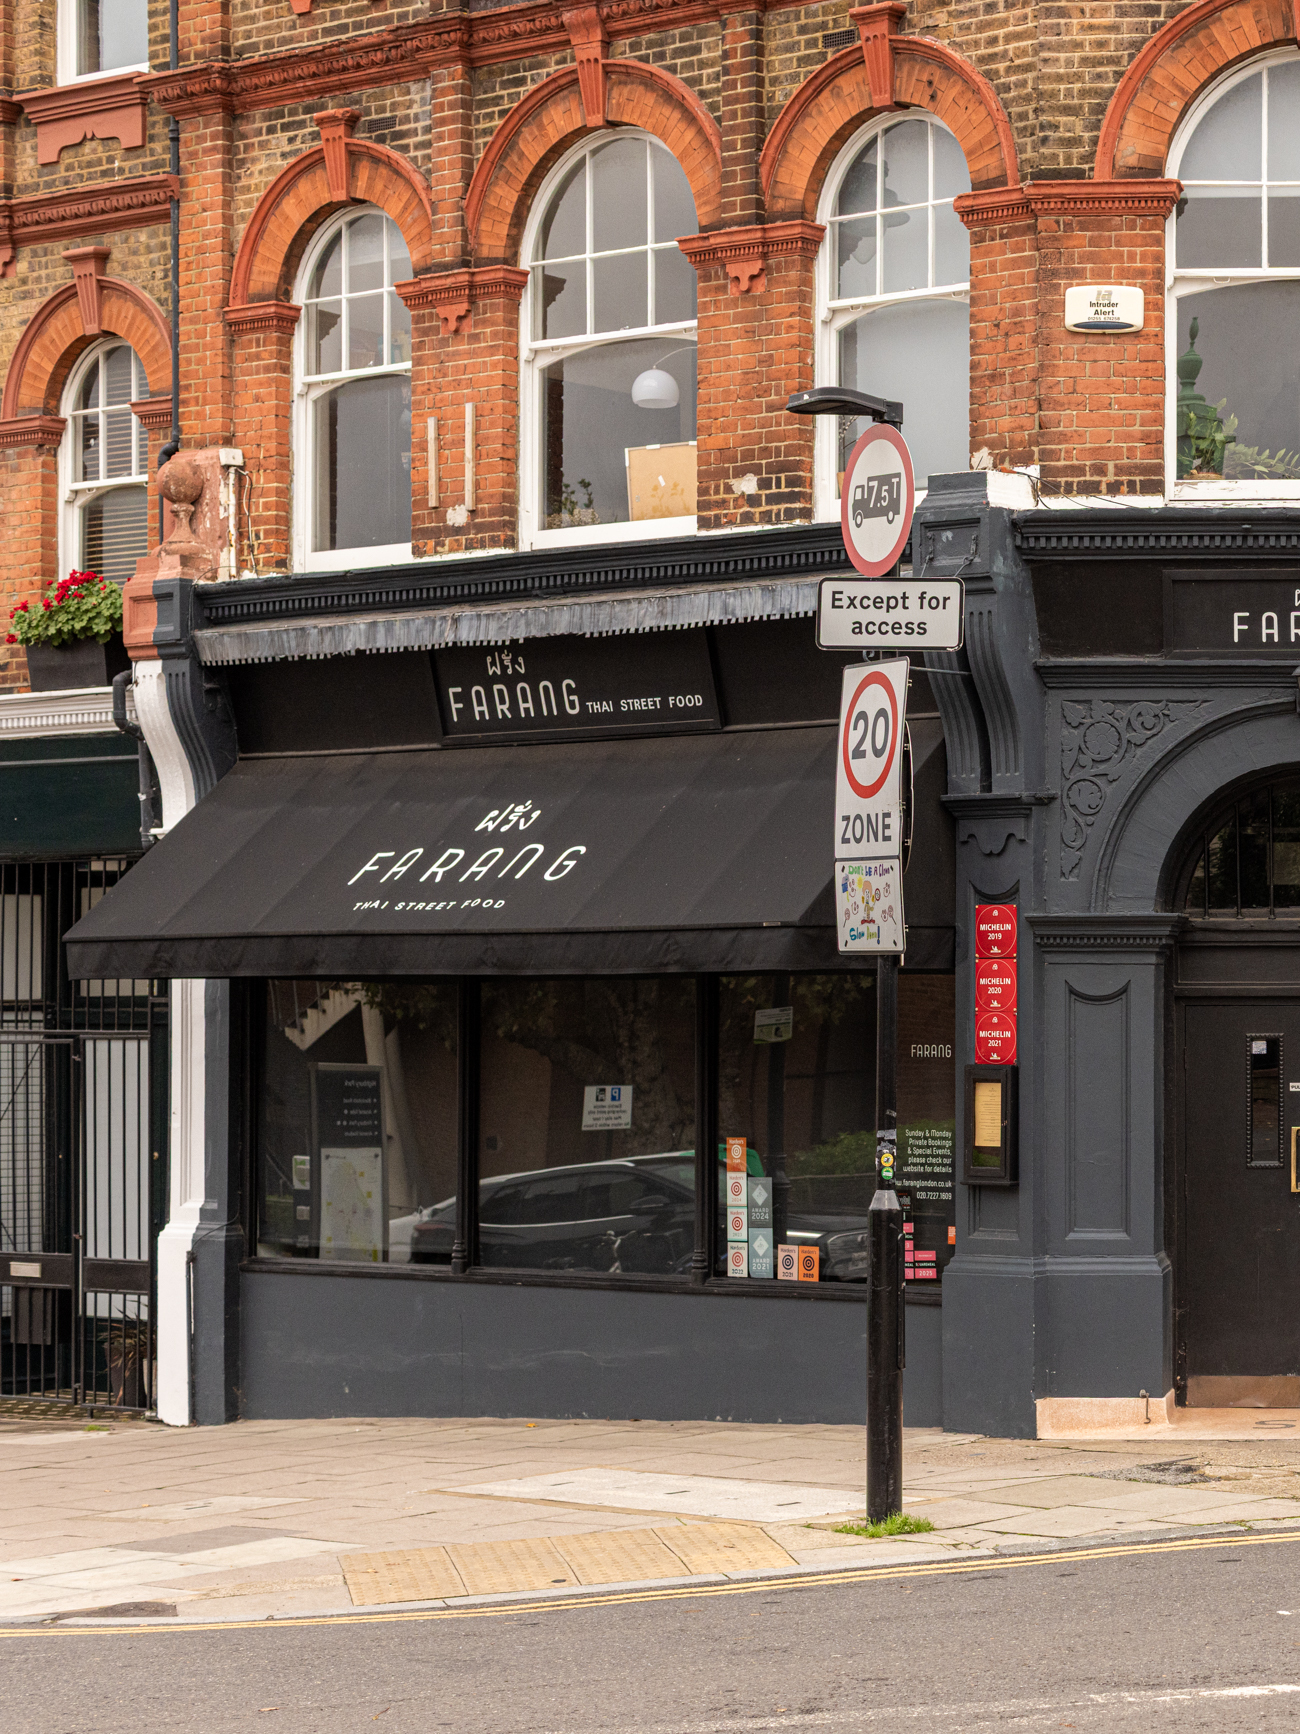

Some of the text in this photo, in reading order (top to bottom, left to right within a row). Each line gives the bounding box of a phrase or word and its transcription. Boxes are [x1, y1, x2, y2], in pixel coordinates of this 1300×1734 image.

[832, 591, 950, 613] Except for
[852, 621, 927, 635] access
[487, 650, 525, 676] ฝรั่ง
[449, 679, 703, 722] FARANG THAI STREET FOOD
[852, 708, 889, 760] 20
[841, 812, 892, 844] ZONE
[348, 844, 587, 886] FARANG
[353, 899, 505, 911] THAI STREET FOOD
[849, 927, 865, 941] Slow
[911, 1045, 951, 1058] FARANG
[906, 1129, 924, 1137] Sunday
[931, 1130, 952, 1138] Monday
[928, 1139, 952, 1147] Bookings
[913, 1147, 932, 1155] Special
[909, 1156, 926, 1164] please
[927, 1156, 942, 1164] check
[917, 1192, 952, 1200] 020.7227.1609
[1253, 1420, 1297, 1429] S
